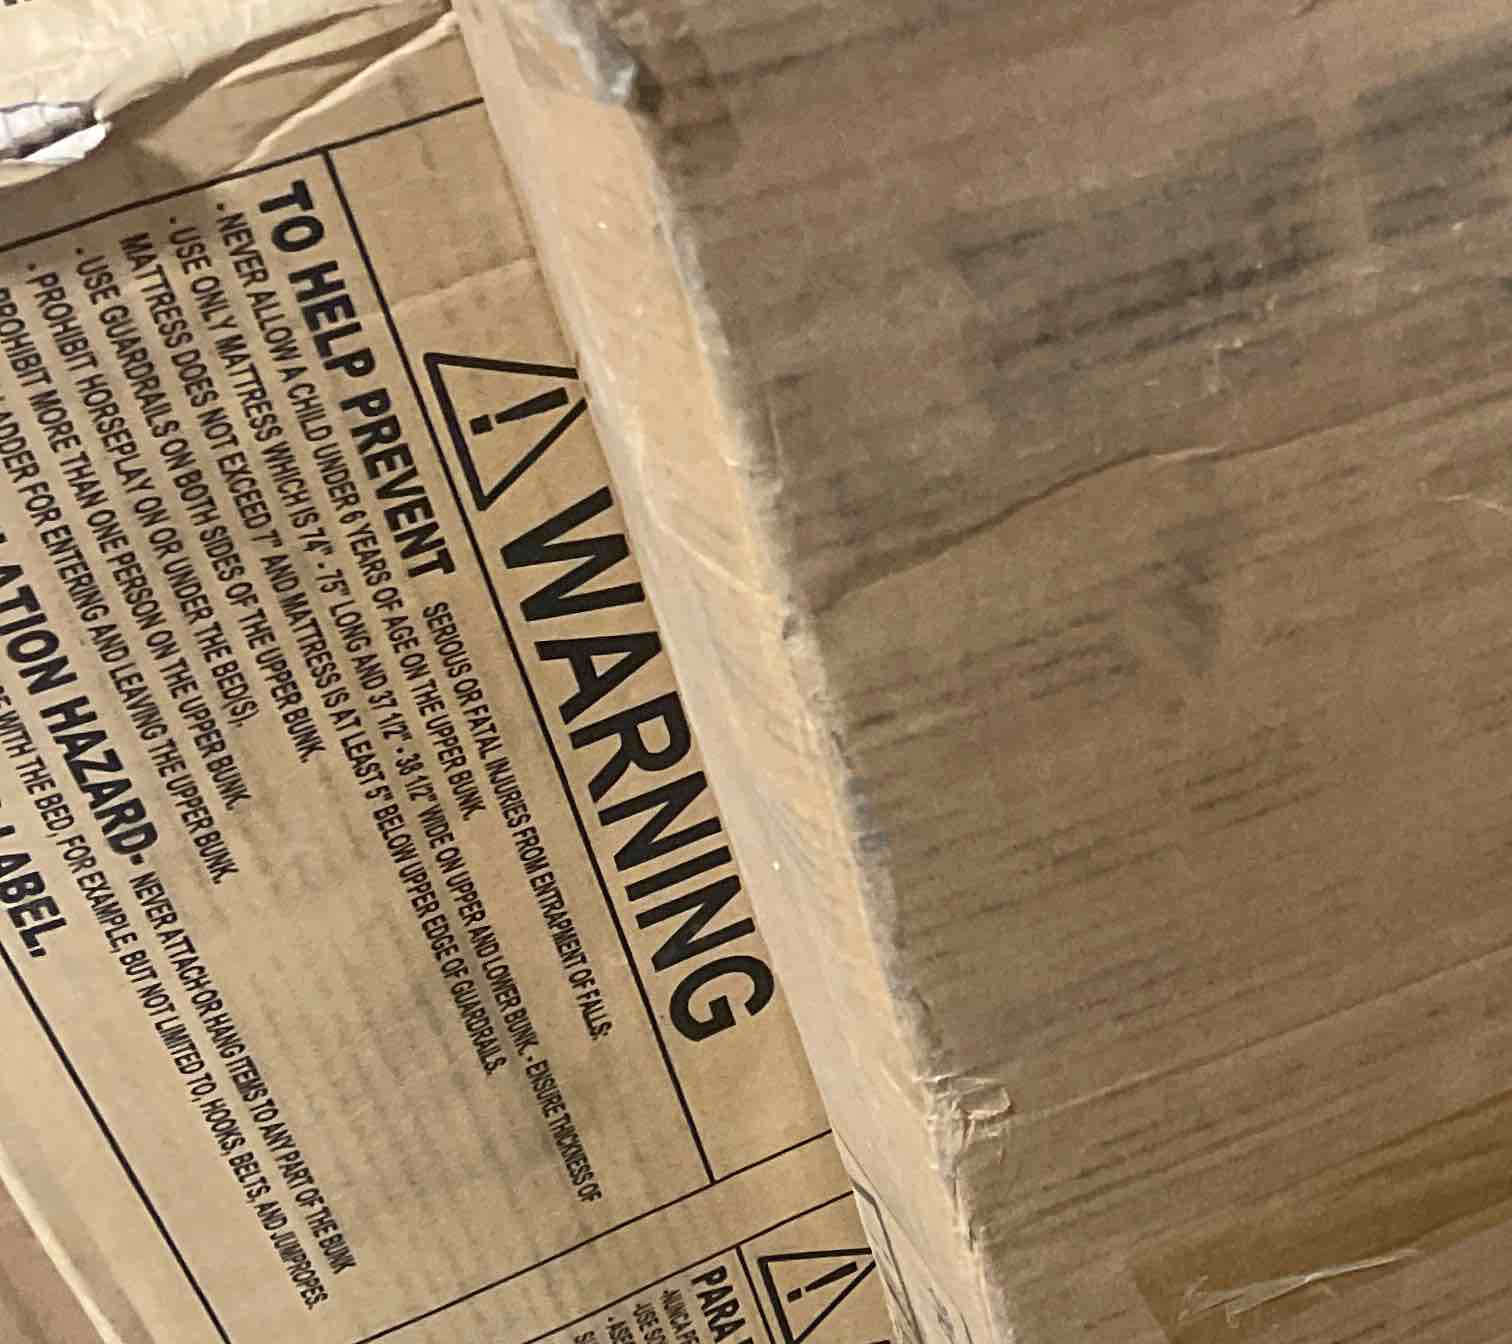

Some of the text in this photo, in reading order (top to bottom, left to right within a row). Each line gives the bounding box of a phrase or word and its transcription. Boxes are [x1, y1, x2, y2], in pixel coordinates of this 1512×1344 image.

[257, 178, 457, 579] TO HELP PREVENT
[27, 388, 83, 454] MORE
[16, 480, 63, 529] FOR
[24, 271, 260, 729] PROHIBIT HORSEPLAY ON OR UNDER THE BED(S).
[58, 450, 110, 510] THAN
[75, 254, 327, 764] USE GUARDRAILS ON BOTH SIDES OF THE UPPER BUNK.
[85, 508, 130, 555] ONE
[215, 211, 487, 822] NEVER ALLOW A CHILD UNDER 6 YEARS OF AGE ON THE UPPER BUNK.
[39, 523, 111, 623] ENTERING
[105, 550, 168, 631] PERSON
[85, 623, 131, 664] AND
[118, 231, 509, 1078] MATTRESS DOES NOT EXCEED 7" AND MATTRESS IS AT LEAST 5" BELOW UPPER EDGE OF GUARDRAILS.
[145, 629, 182, 661] ON
[107, 661, 169, 741] LEAVING
[159, 656, 200, 700] THE
[177, 694, 227, 760] UPPER
[15, 753, 57, 796] THE
[38, 694, 159, 866] HAZARD-
[146, 736, 188, 779] THE
[205, 753, 253, 812] BUNK.
[500, 485, 776, 1042] WARNING
[33, 791, 75, 839] BED,
[165, 772, 215, 836] UPPER
[421, 601, 613, 1042] SERIOUS OR FATAL INJURIES FROM ENTRAPMENT OF FALLS:
[55, 833, 98, 875] FOR
[192, 829, 240, 885] BUNK.
[75, 870, 139, 954] EXAMPLE,
[118, 948, 159, 984] BUT
[135, 981, 177, 1017] NOT
[127, 870, 357, 1275] NEVER ATTACH OR HANG ITEMS TO ANY PART OF THE BUNK
[153, 1015, 206, 1075] LIMITED
[185, 1071, 218, 1103] TO,
[199, 1096, 247, 1157] HOOKS,
[228, 1151, 272, 1204] BELTS,
[253, 1200, 289, 1231] AND
[269, 1230, 329, 1311] JUMPROPES.
